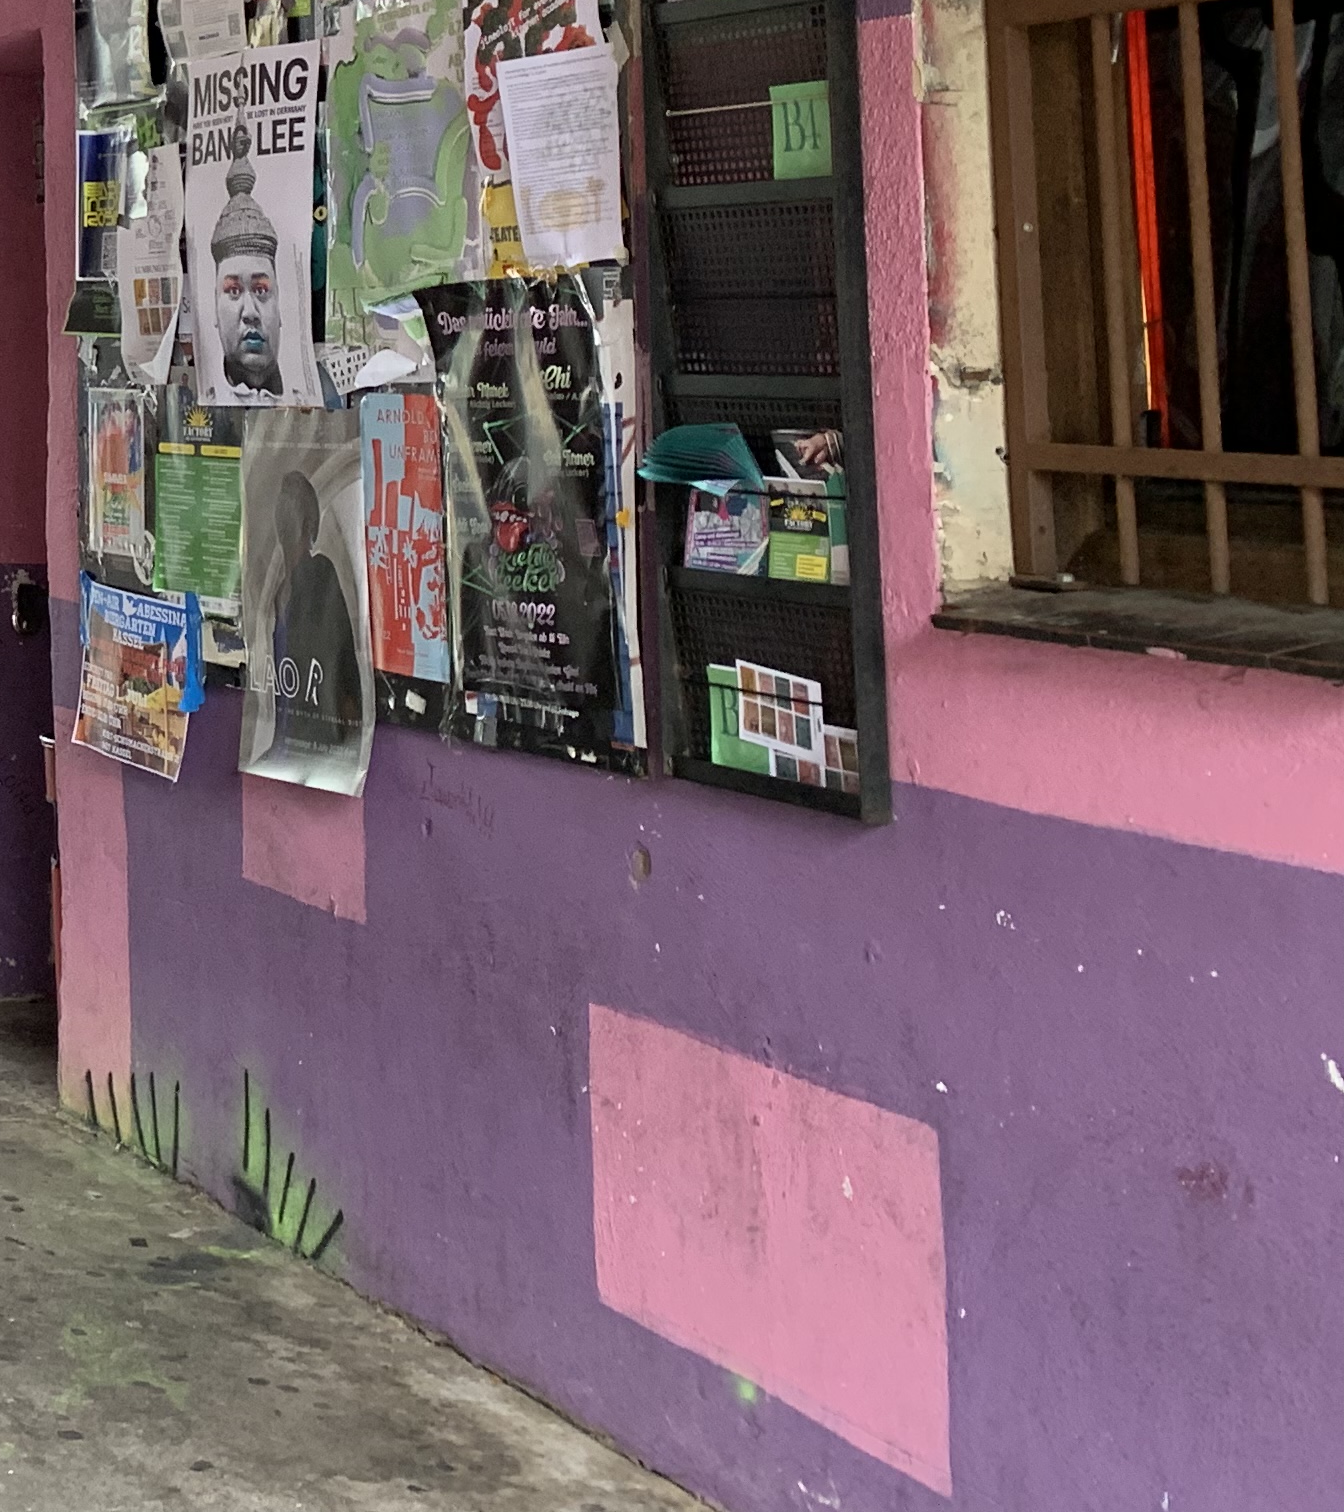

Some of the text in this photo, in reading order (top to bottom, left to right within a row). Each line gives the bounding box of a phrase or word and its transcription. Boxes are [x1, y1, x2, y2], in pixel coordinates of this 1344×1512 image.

[194, 58, 309, 118] MISSING
[276, 105, 307, 115] GERMANY
[192, 116, 306, 166] BANG LEE
